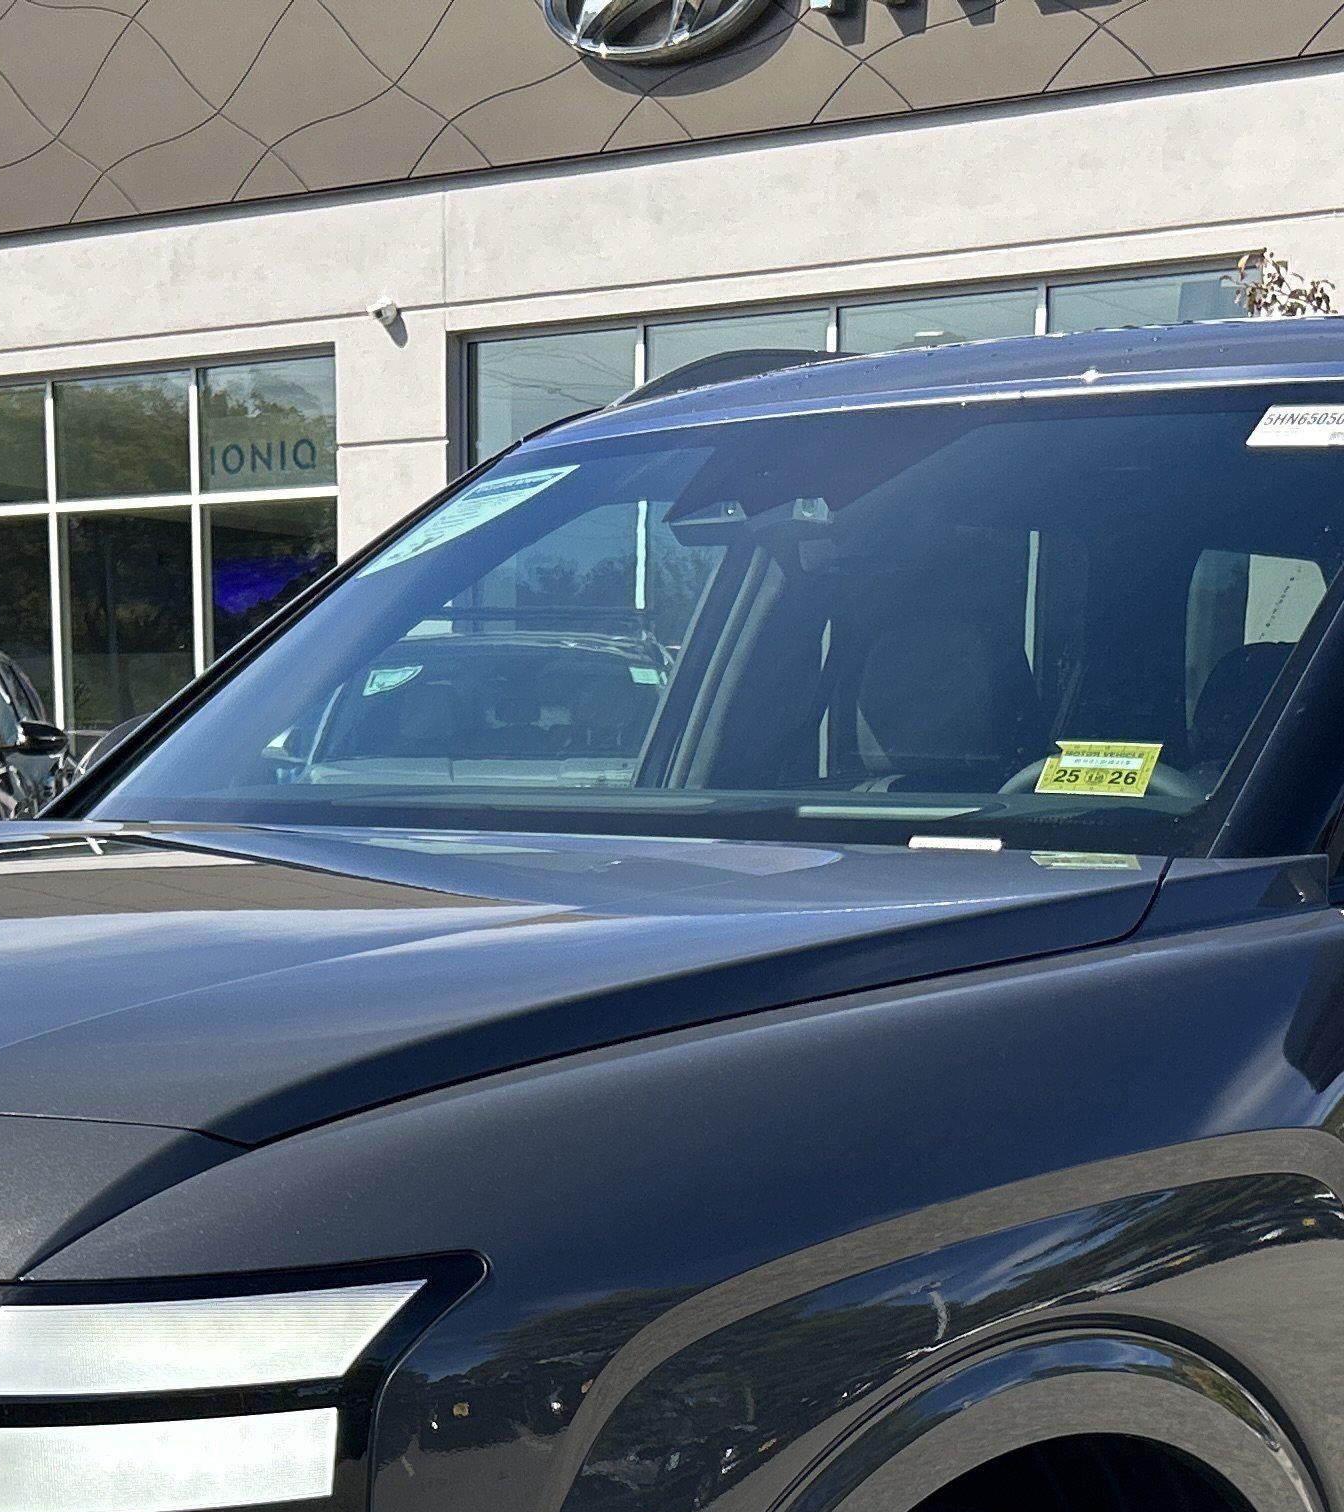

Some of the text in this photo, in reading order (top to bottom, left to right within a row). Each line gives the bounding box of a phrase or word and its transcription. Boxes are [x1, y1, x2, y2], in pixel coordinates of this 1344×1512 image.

[209, 438, 317, 476] IONIQ
[1053, 769, 1137, 785] 25 26
